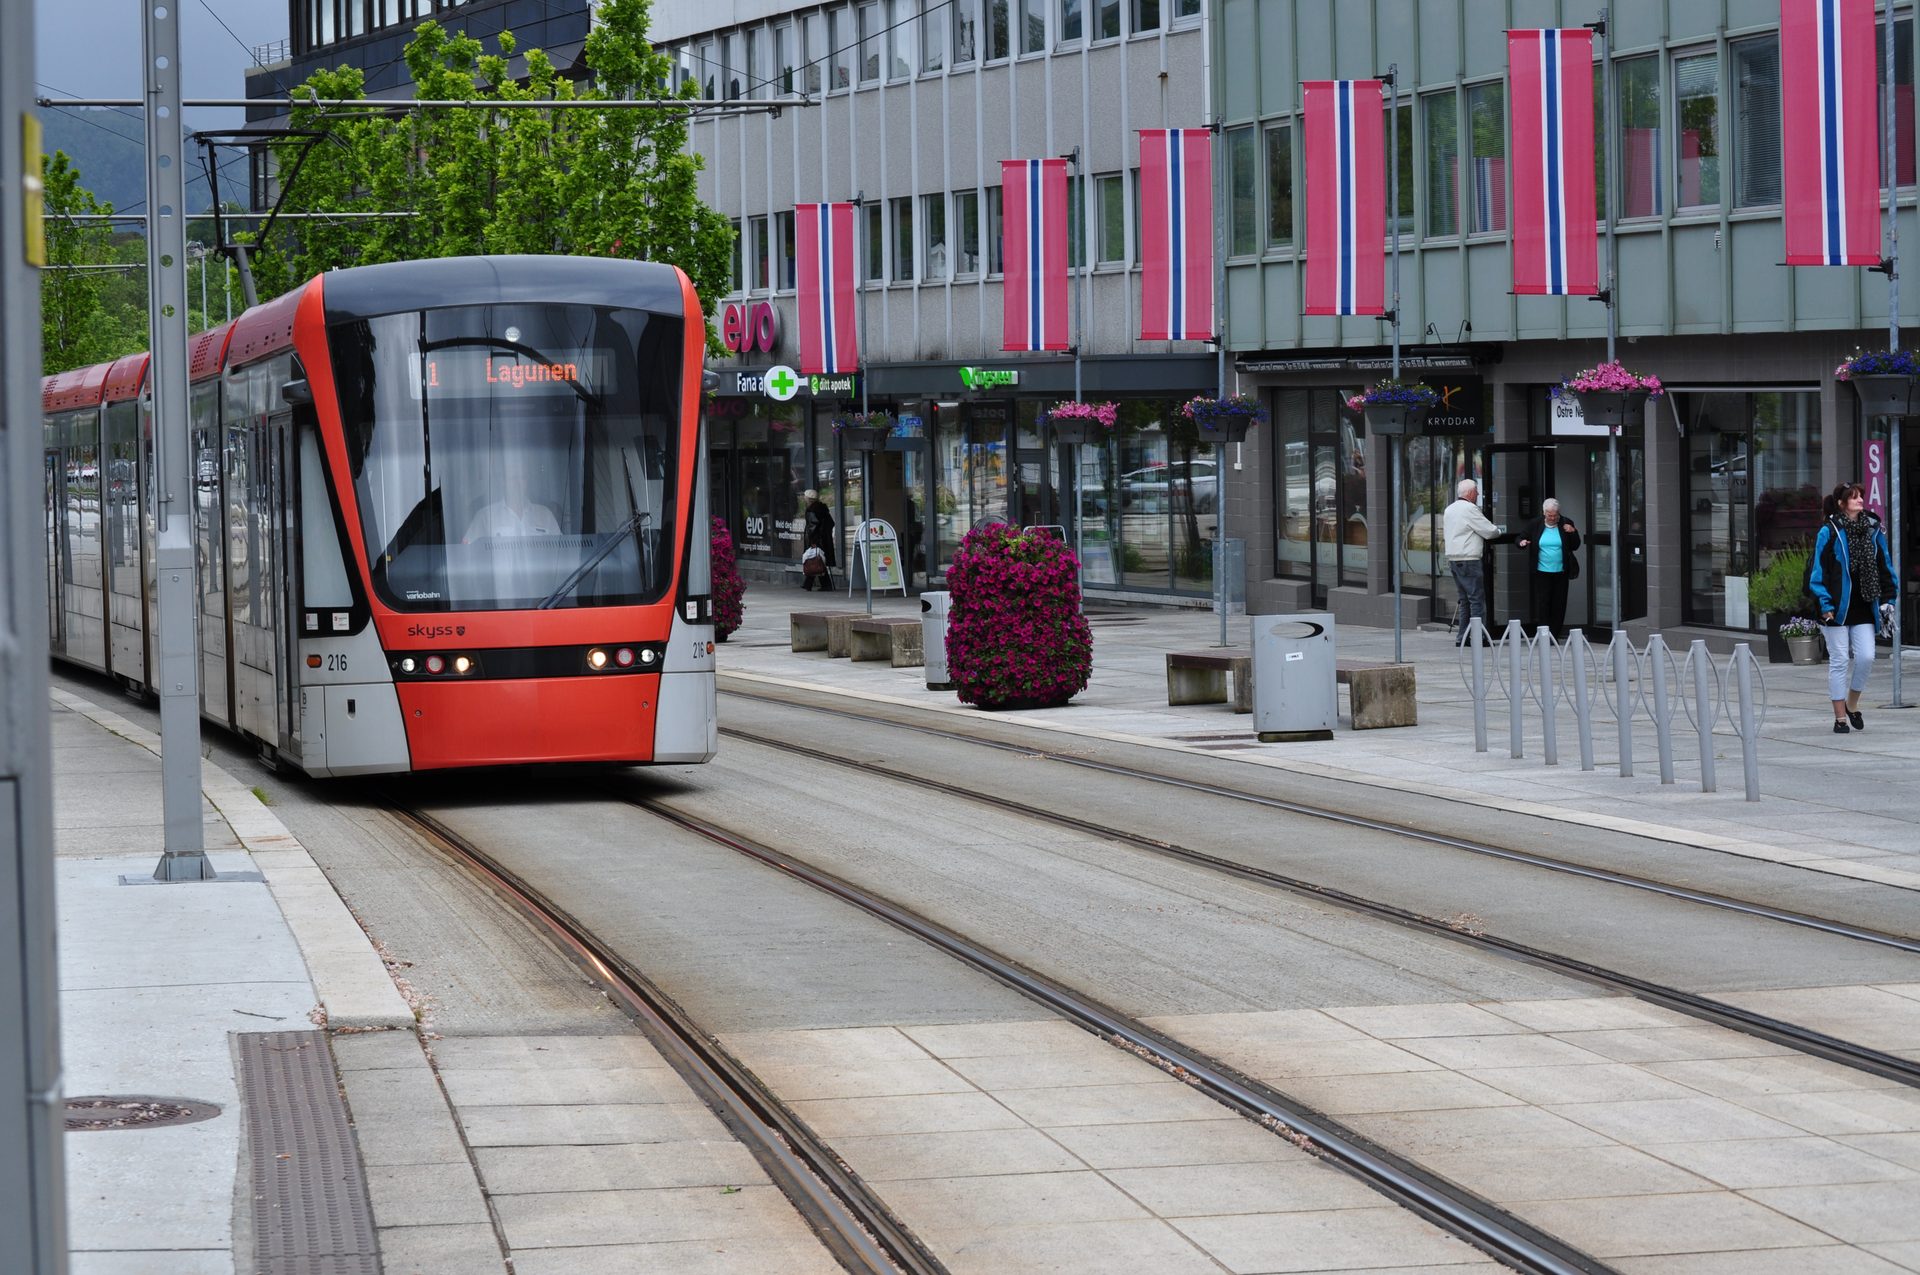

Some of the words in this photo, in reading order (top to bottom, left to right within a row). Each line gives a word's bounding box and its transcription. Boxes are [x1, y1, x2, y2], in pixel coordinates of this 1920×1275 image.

[723, 302, 775, 352] evo
[428, 362, 439, 387] 1
[486, 357, 577, 388] Lagunen
[737, 373, 760, 392] Fana
[820, 377, 830, 391] ditt
[831, 377, 851, 394] apotek
[1428, 417, 1475, 426] KRYDDAR
[746, 516, 764, 535] evo
[408, 624, 453, 639] skyss
[693, 642, 705, 659] 216
[328, 654, 348, 672] 216
